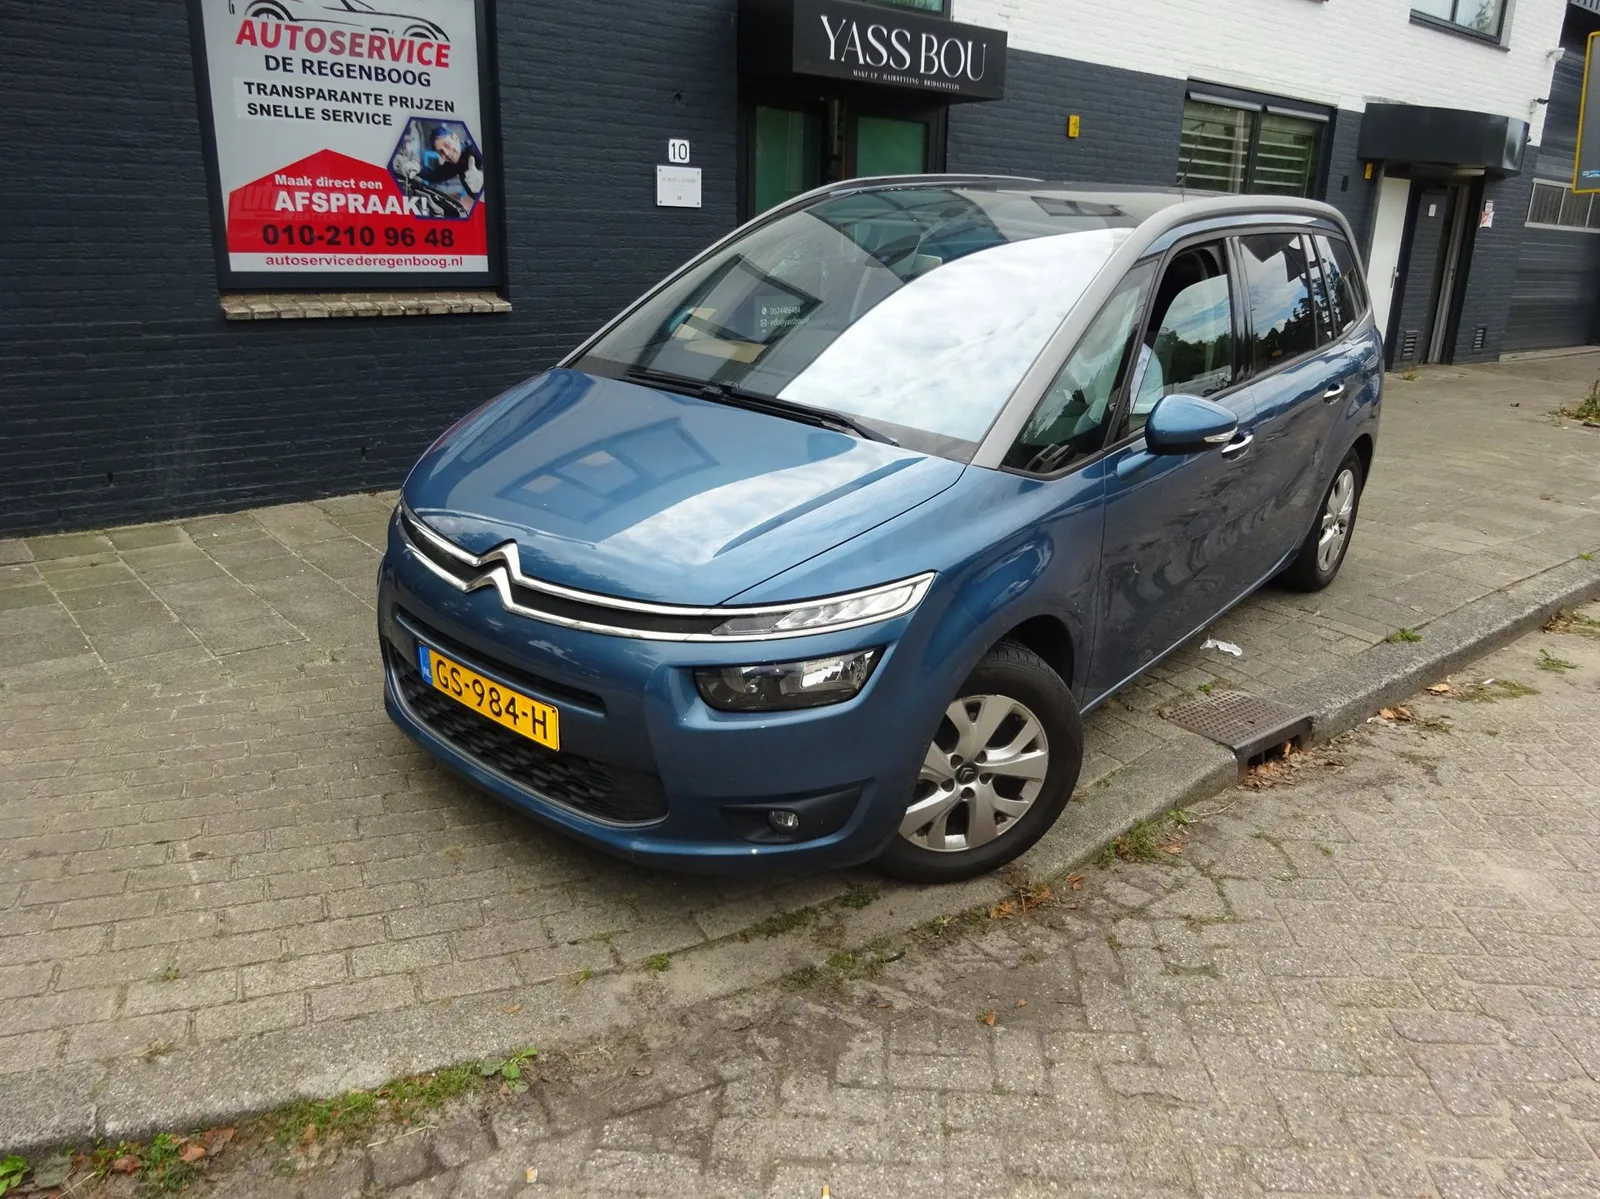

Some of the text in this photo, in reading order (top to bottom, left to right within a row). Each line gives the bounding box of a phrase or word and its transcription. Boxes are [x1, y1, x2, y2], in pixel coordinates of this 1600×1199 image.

[235, 19, 451, 68] AUTOSERVICE
[820, 14, 987, 82] YASS BOU
[264, 54, 432, 87] DE REGENBOOG
[852, 69, 868, 78] MAKE
[243, 81, 455, 113] TRANSPARANTE PRIJZEN
[247, 103, 392, 126] SNELLE SERVICE
[671, 142, 688, 160] 10
[275, 174, 383, 190] Maak direct een
[274, 190, 429, 216] AFSPRAAK!
[262, 224, 455, 248] 010-210 96 48
[265, 255, 463, 269] autoservicederegenboog.nl
[436, 659, 547, 740] GS-984-H
